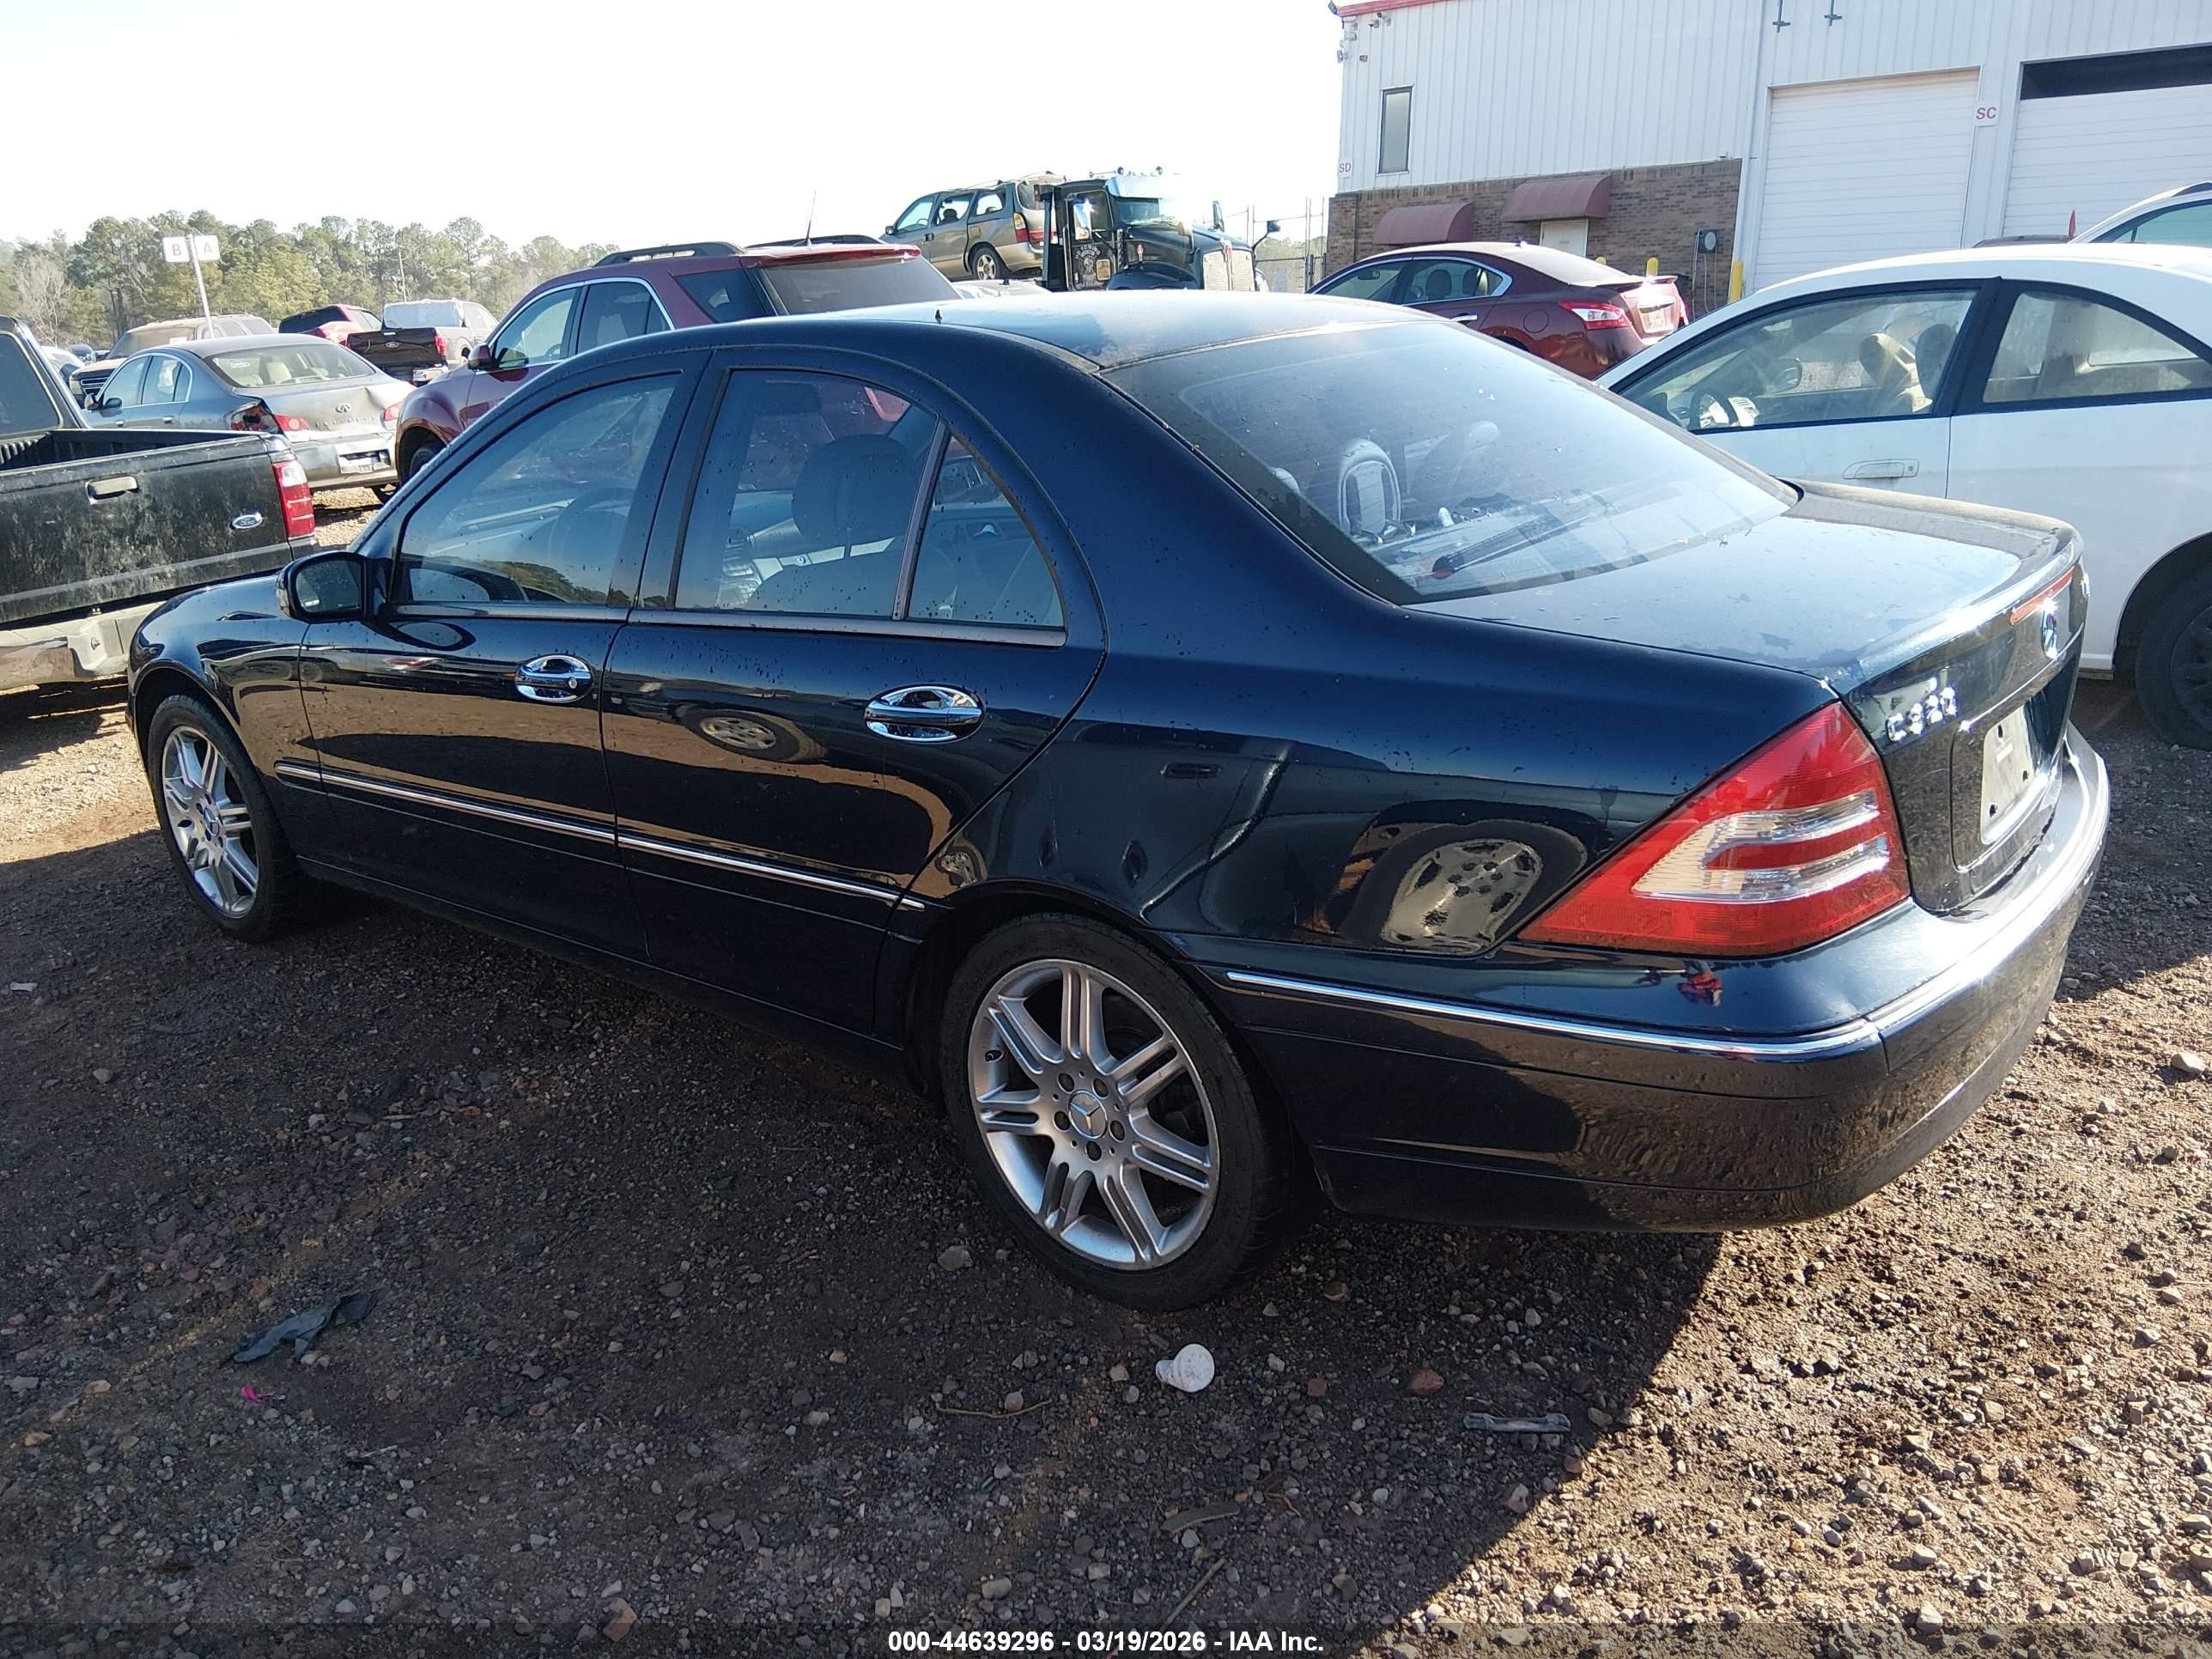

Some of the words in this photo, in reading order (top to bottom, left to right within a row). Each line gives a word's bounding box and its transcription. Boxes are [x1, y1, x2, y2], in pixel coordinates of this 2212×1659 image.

[1976, 106, 1996, 119] SC
[1339, 162, 1352, 173] SD
[172, 244, 181, 255] B
[204, 242, 213, 254] A
